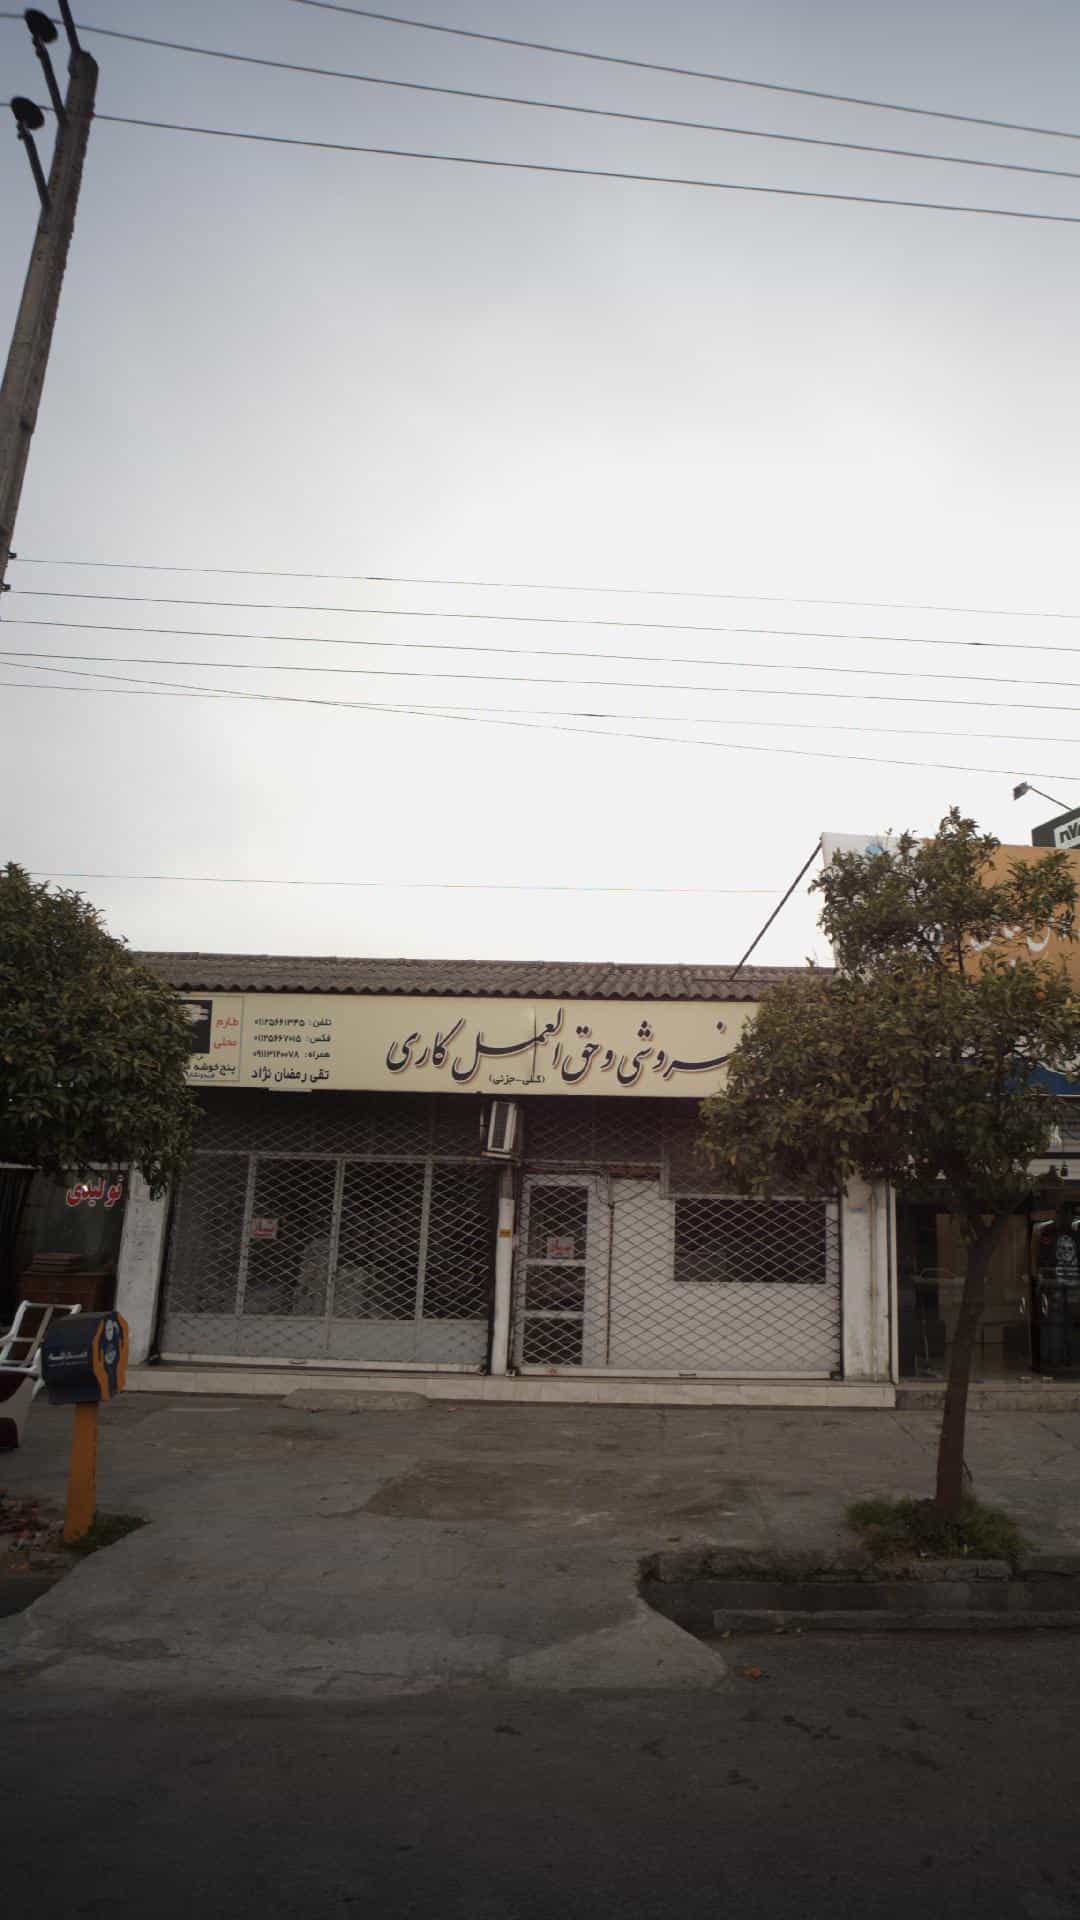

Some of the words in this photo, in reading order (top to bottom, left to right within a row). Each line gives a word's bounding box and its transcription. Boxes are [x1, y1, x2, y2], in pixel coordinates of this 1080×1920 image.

[386, 1016, 466, 1074] کاری
[560, 1025, 600, 1084] حق
[599, 1048, 615, 1070] و
[251, 1065, 271, 1081] نژاد
[274, 1067, 308, 1082] رمضان
[310, 1068, 330, 1083] تقی
